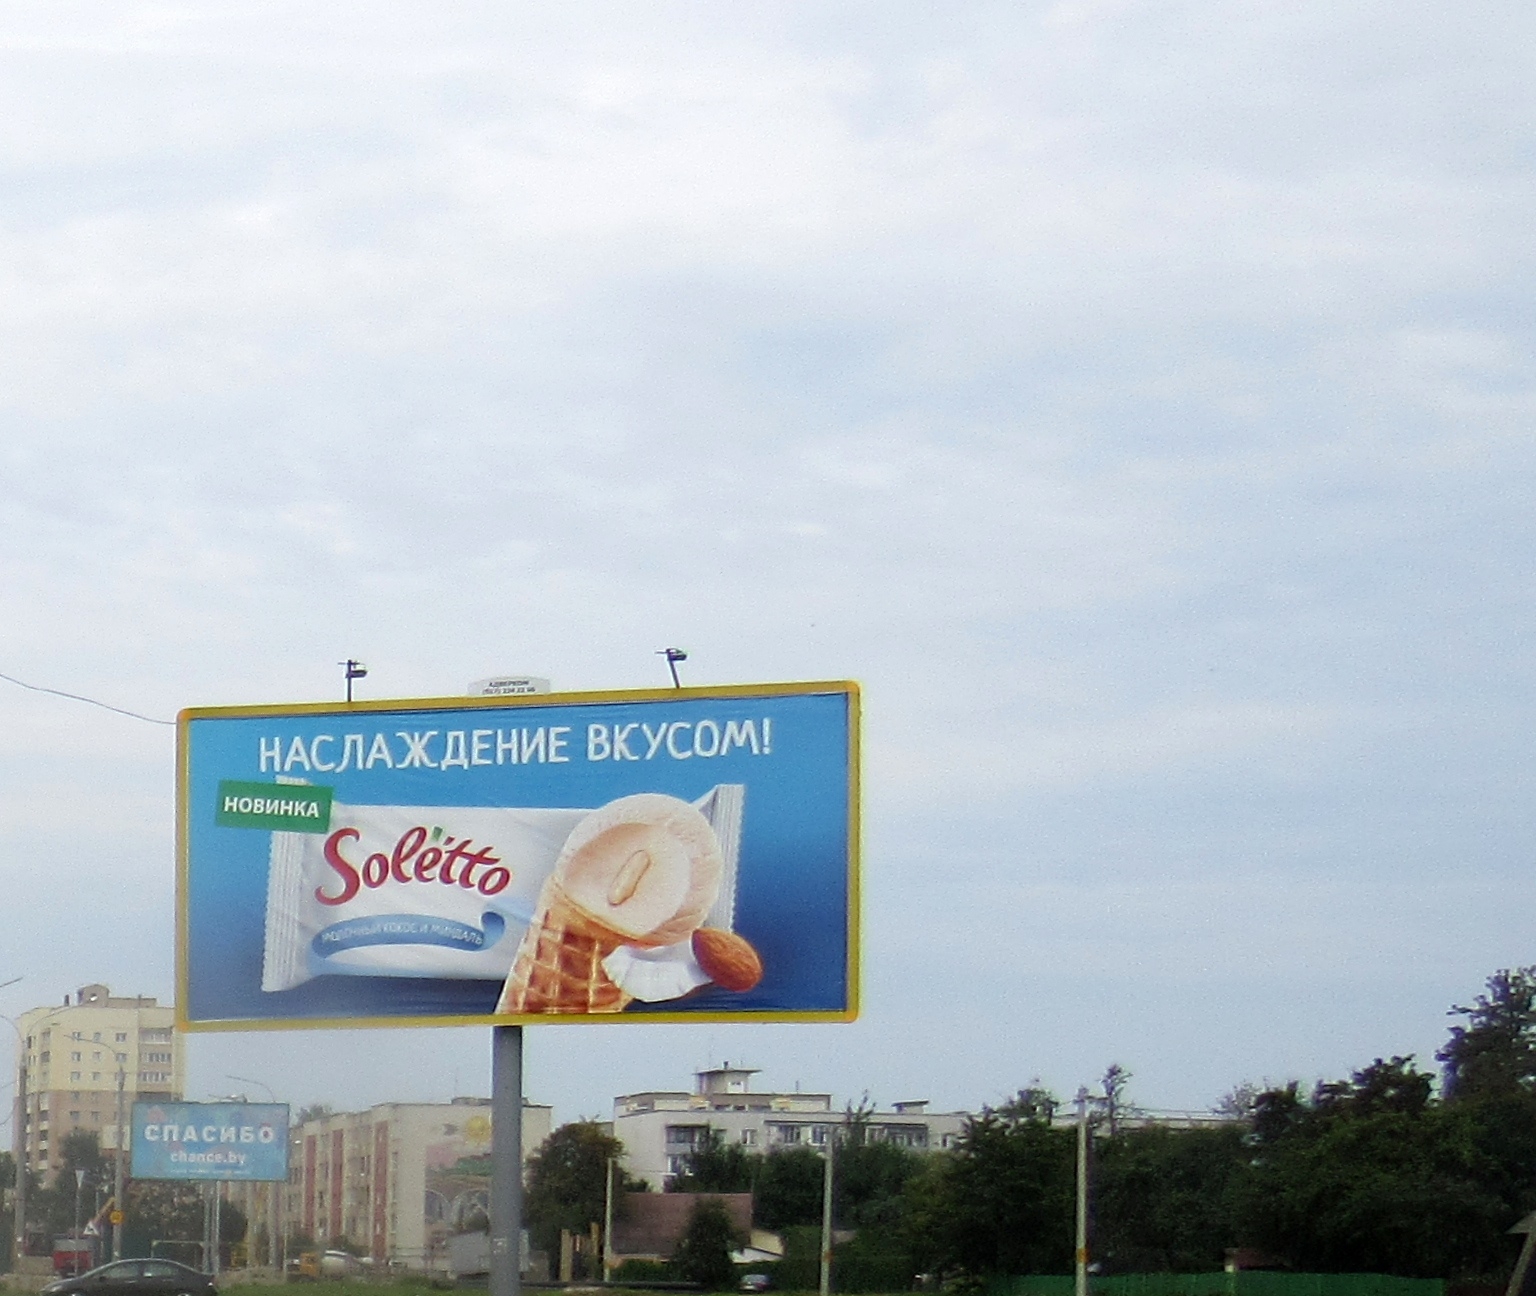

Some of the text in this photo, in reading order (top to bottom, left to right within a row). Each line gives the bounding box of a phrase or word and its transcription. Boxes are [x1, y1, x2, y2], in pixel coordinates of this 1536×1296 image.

[258, 716, 771, 773] НАСЛАЖДЕНИЕ ВКУСОМ!
[223, 796, 320, 819] НОВИНКА
[144, 1123, 275, 1144] СПАСИБО
[170, 1151, 246, 1166] chance.by
